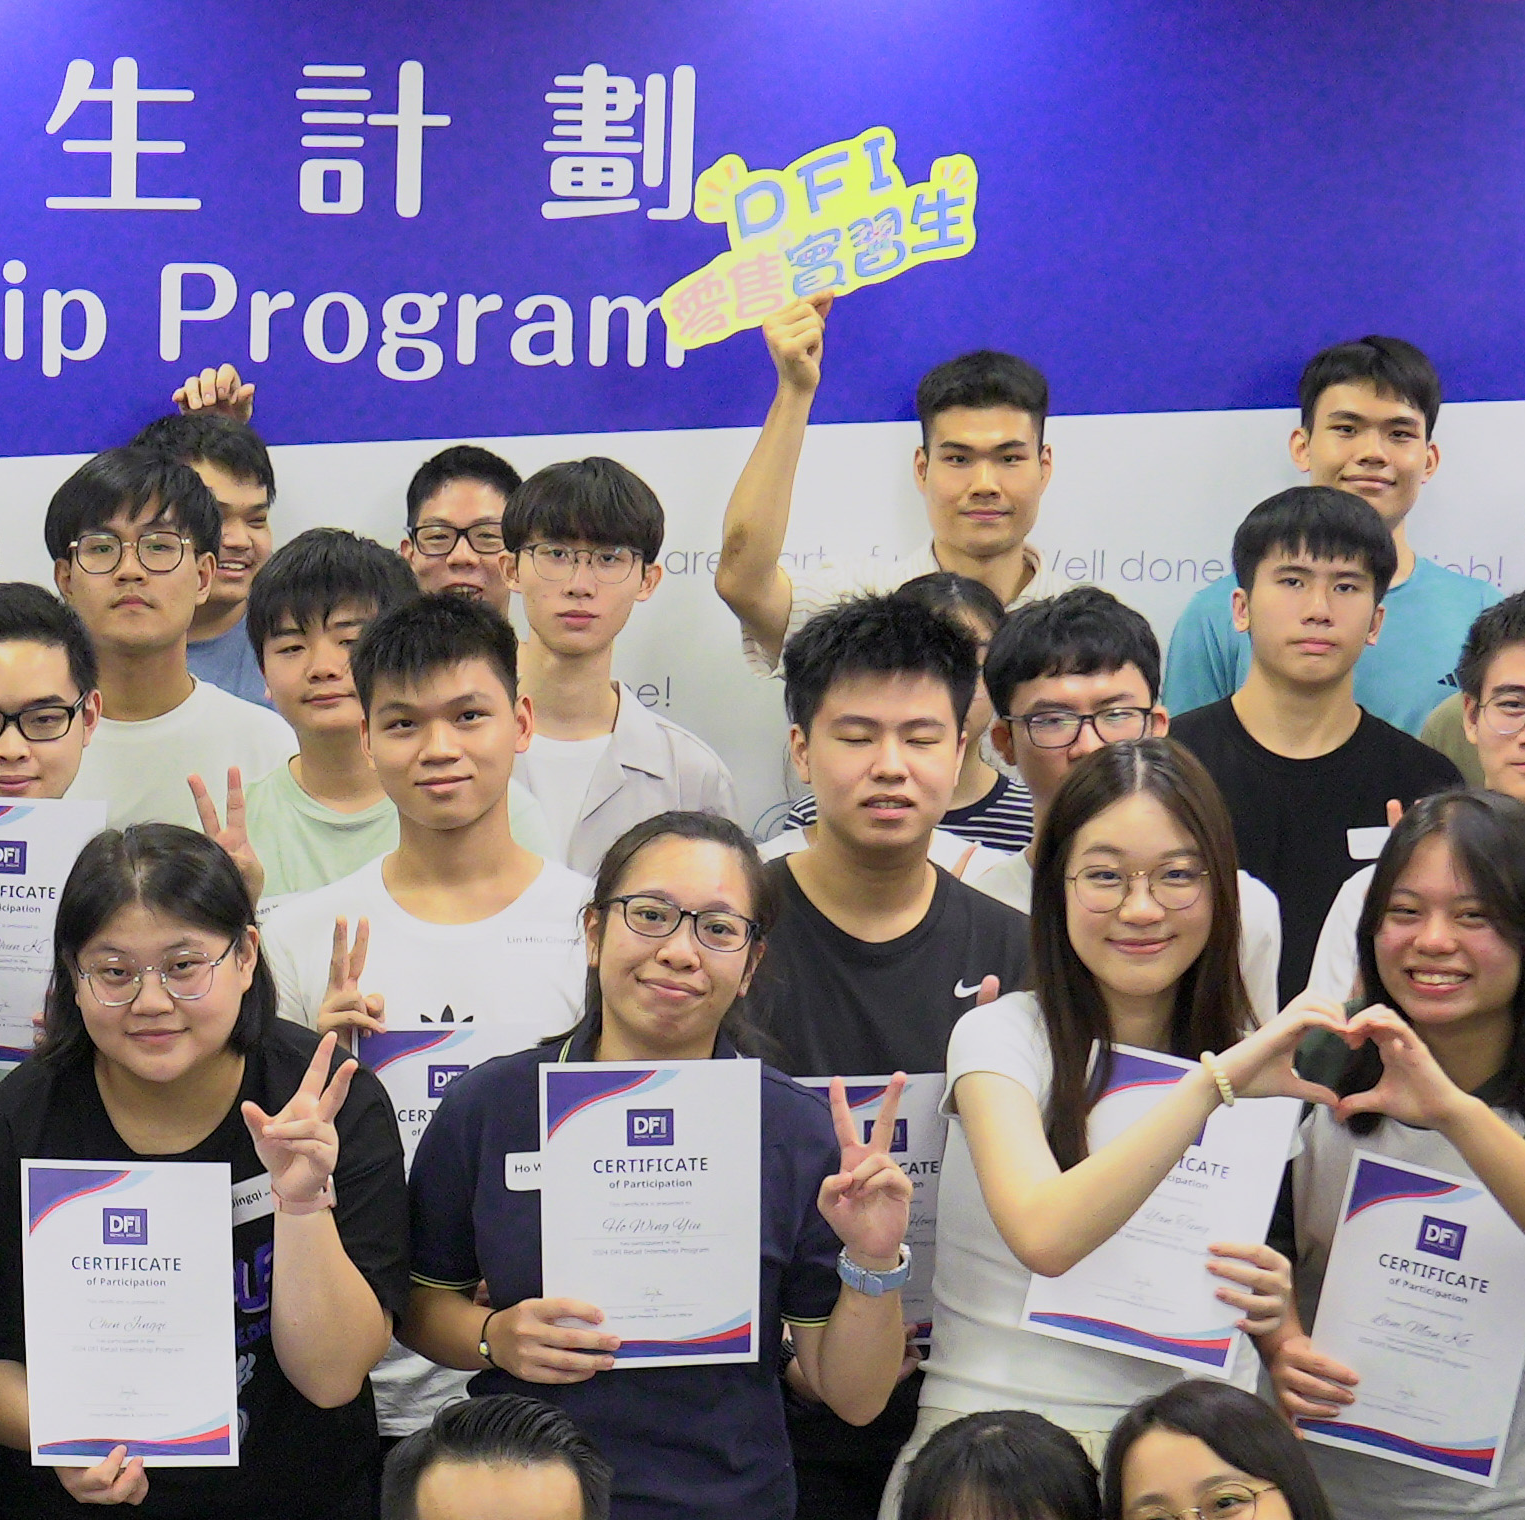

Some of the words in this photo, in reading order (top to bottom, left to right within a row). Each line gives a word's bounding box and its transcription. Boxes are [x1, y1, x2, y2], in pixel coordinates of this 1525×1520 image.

[734, 136, 892, 239] DFI
[670, 188, 965, 339] 零售實習生
[158, 261, 686, 382] Program
[633, 1116, 667, 1134] DFI
[514, 1163, 530, 1173] Ho
[593, 1157, 708, 1173] CERTIFICATE
[609, 1180, 620, 1189] of
[623, 1179, 692, 1190] Participation
[109, 1215, 141, 1233] DFI
[1425, 1224, 1457, 1247] DFI
[71, 1256, 182, 1271] CERTIFICATE
[86, 1277, 96, 1285] of
[100, 1278, 166, 1288] Participation
[1379, 1253, 1489, 1294] CERTIFICATE
[1389, 1278, 1400, 1286] of
[1402, 1281, 1468, 1304] Participation
